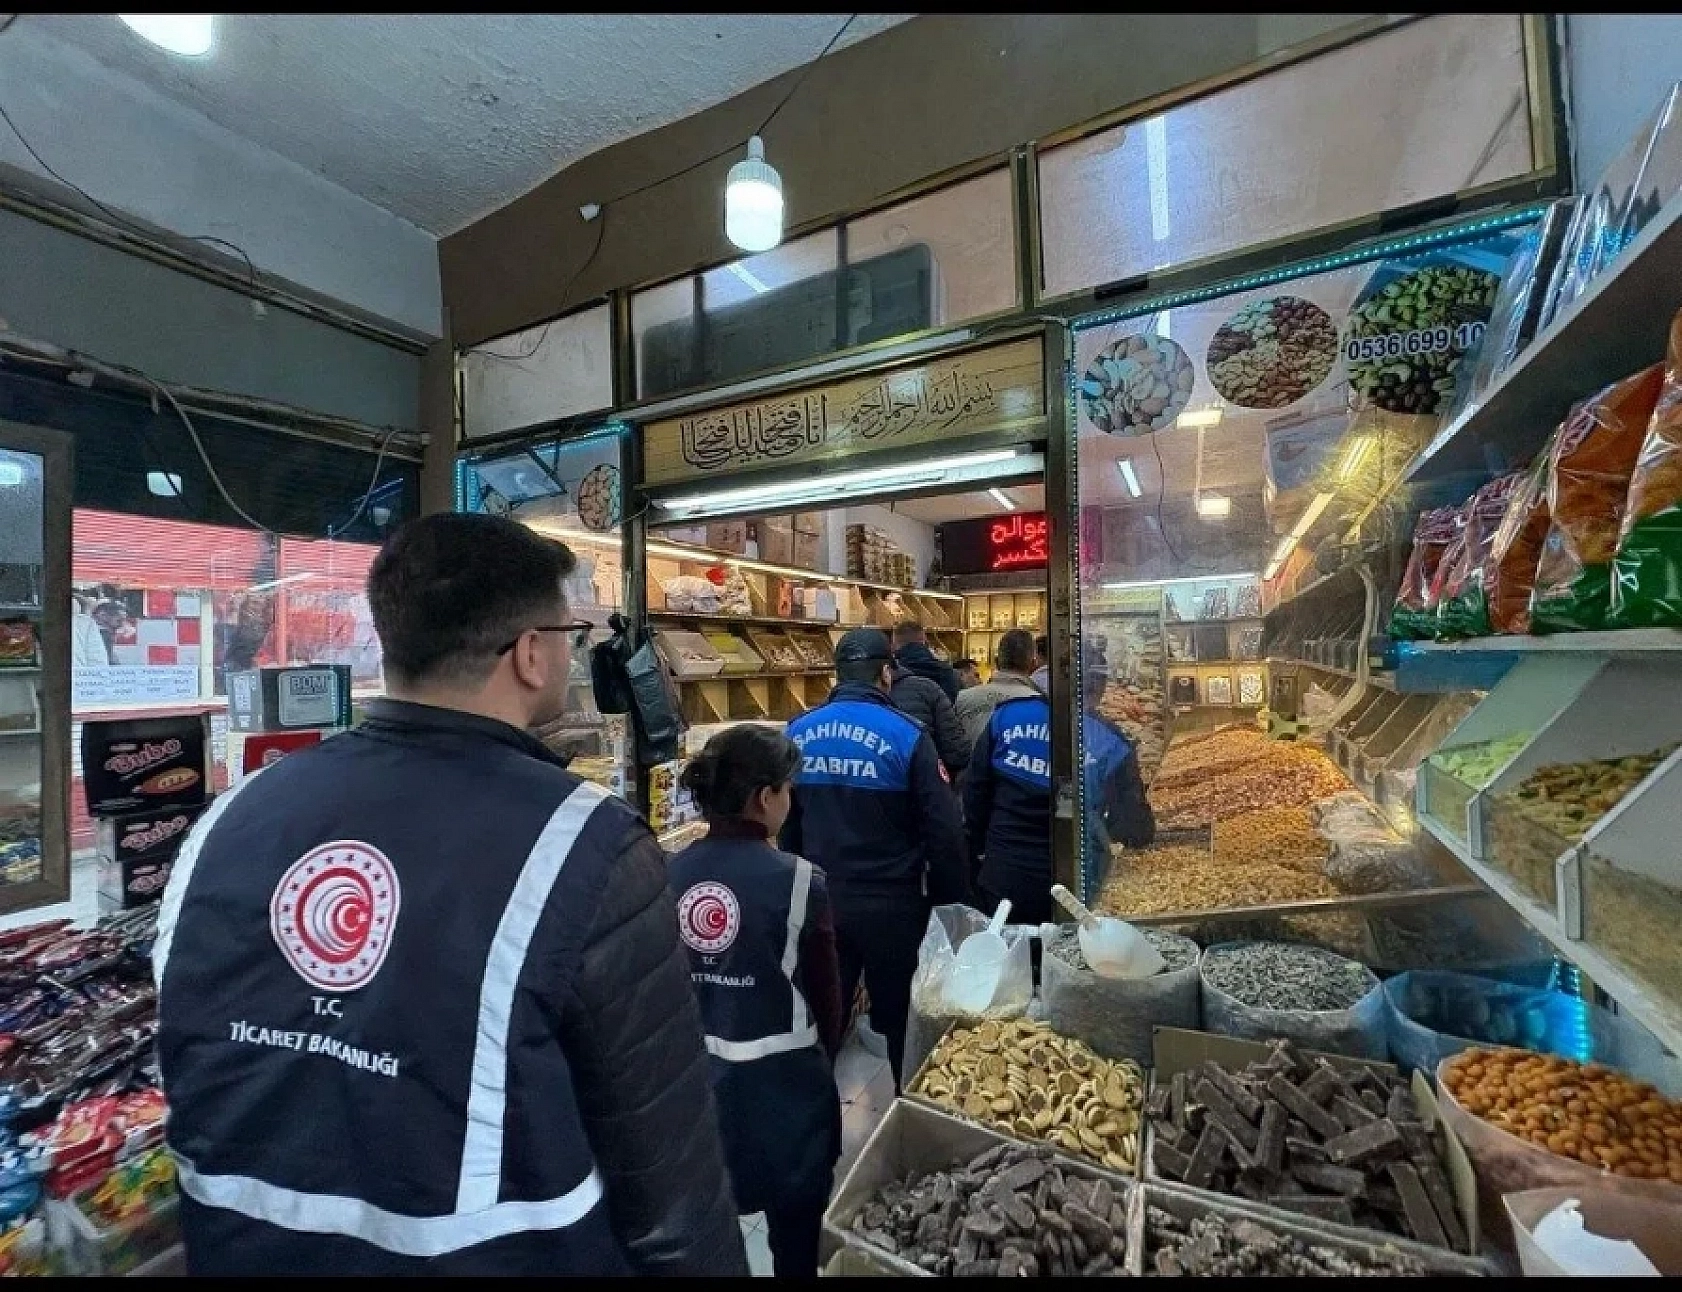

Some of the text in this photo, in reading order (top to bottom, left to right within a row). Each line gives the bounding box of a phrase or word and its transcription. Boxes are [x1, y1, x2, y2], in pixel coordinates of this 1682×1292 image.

[1348, 333, 1401, 361] 0536
[1407, 327, 1451, 354] 699
[802, 756, 879, 779] ZABITA
[229, 1020, 399, 1078] TİCARET BAKANLIĞI
